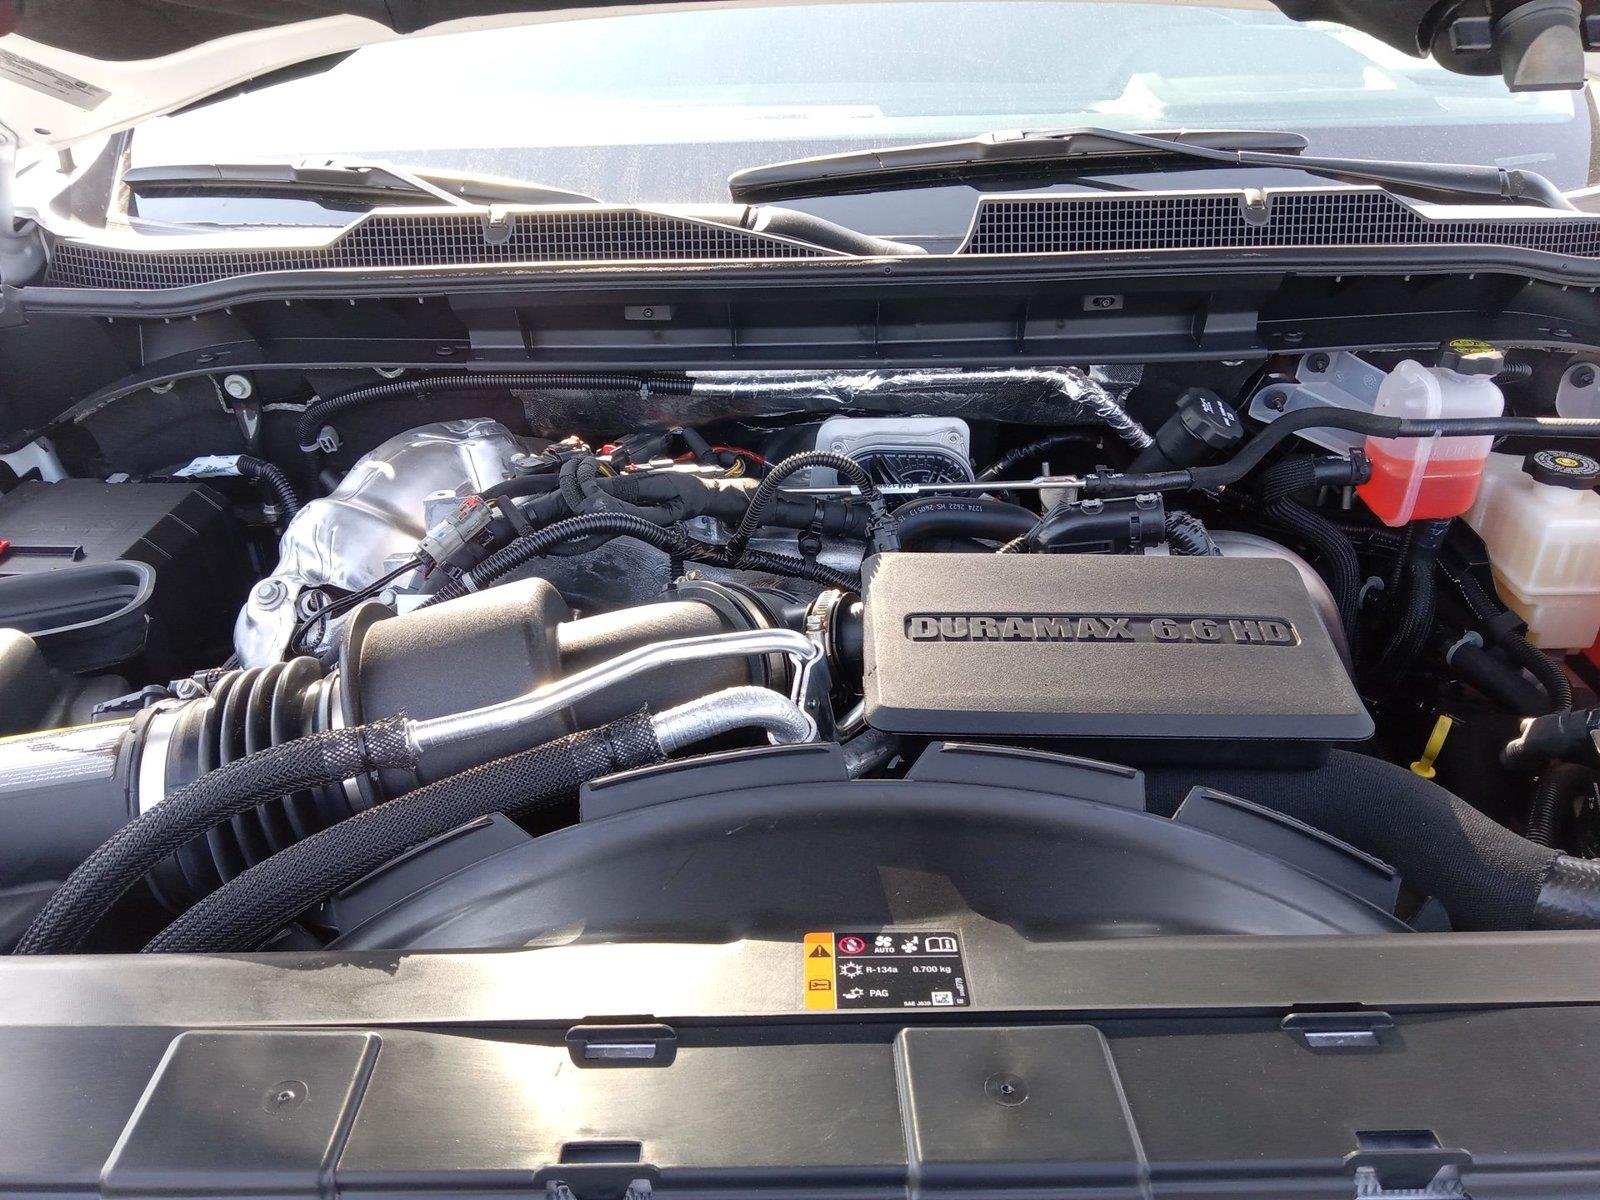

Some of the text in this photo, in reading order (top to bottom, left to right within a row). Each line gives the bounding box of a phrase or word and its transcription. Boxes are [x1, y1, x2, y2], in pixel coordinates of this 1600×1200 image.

[910, 616, 1293, 644] DURAMAX 6.6 HD
[865, 966, 898, 974] R-134a
[912, 965, 952, 974] 0.700 kg
[869, 989, 889, 998] PAG
